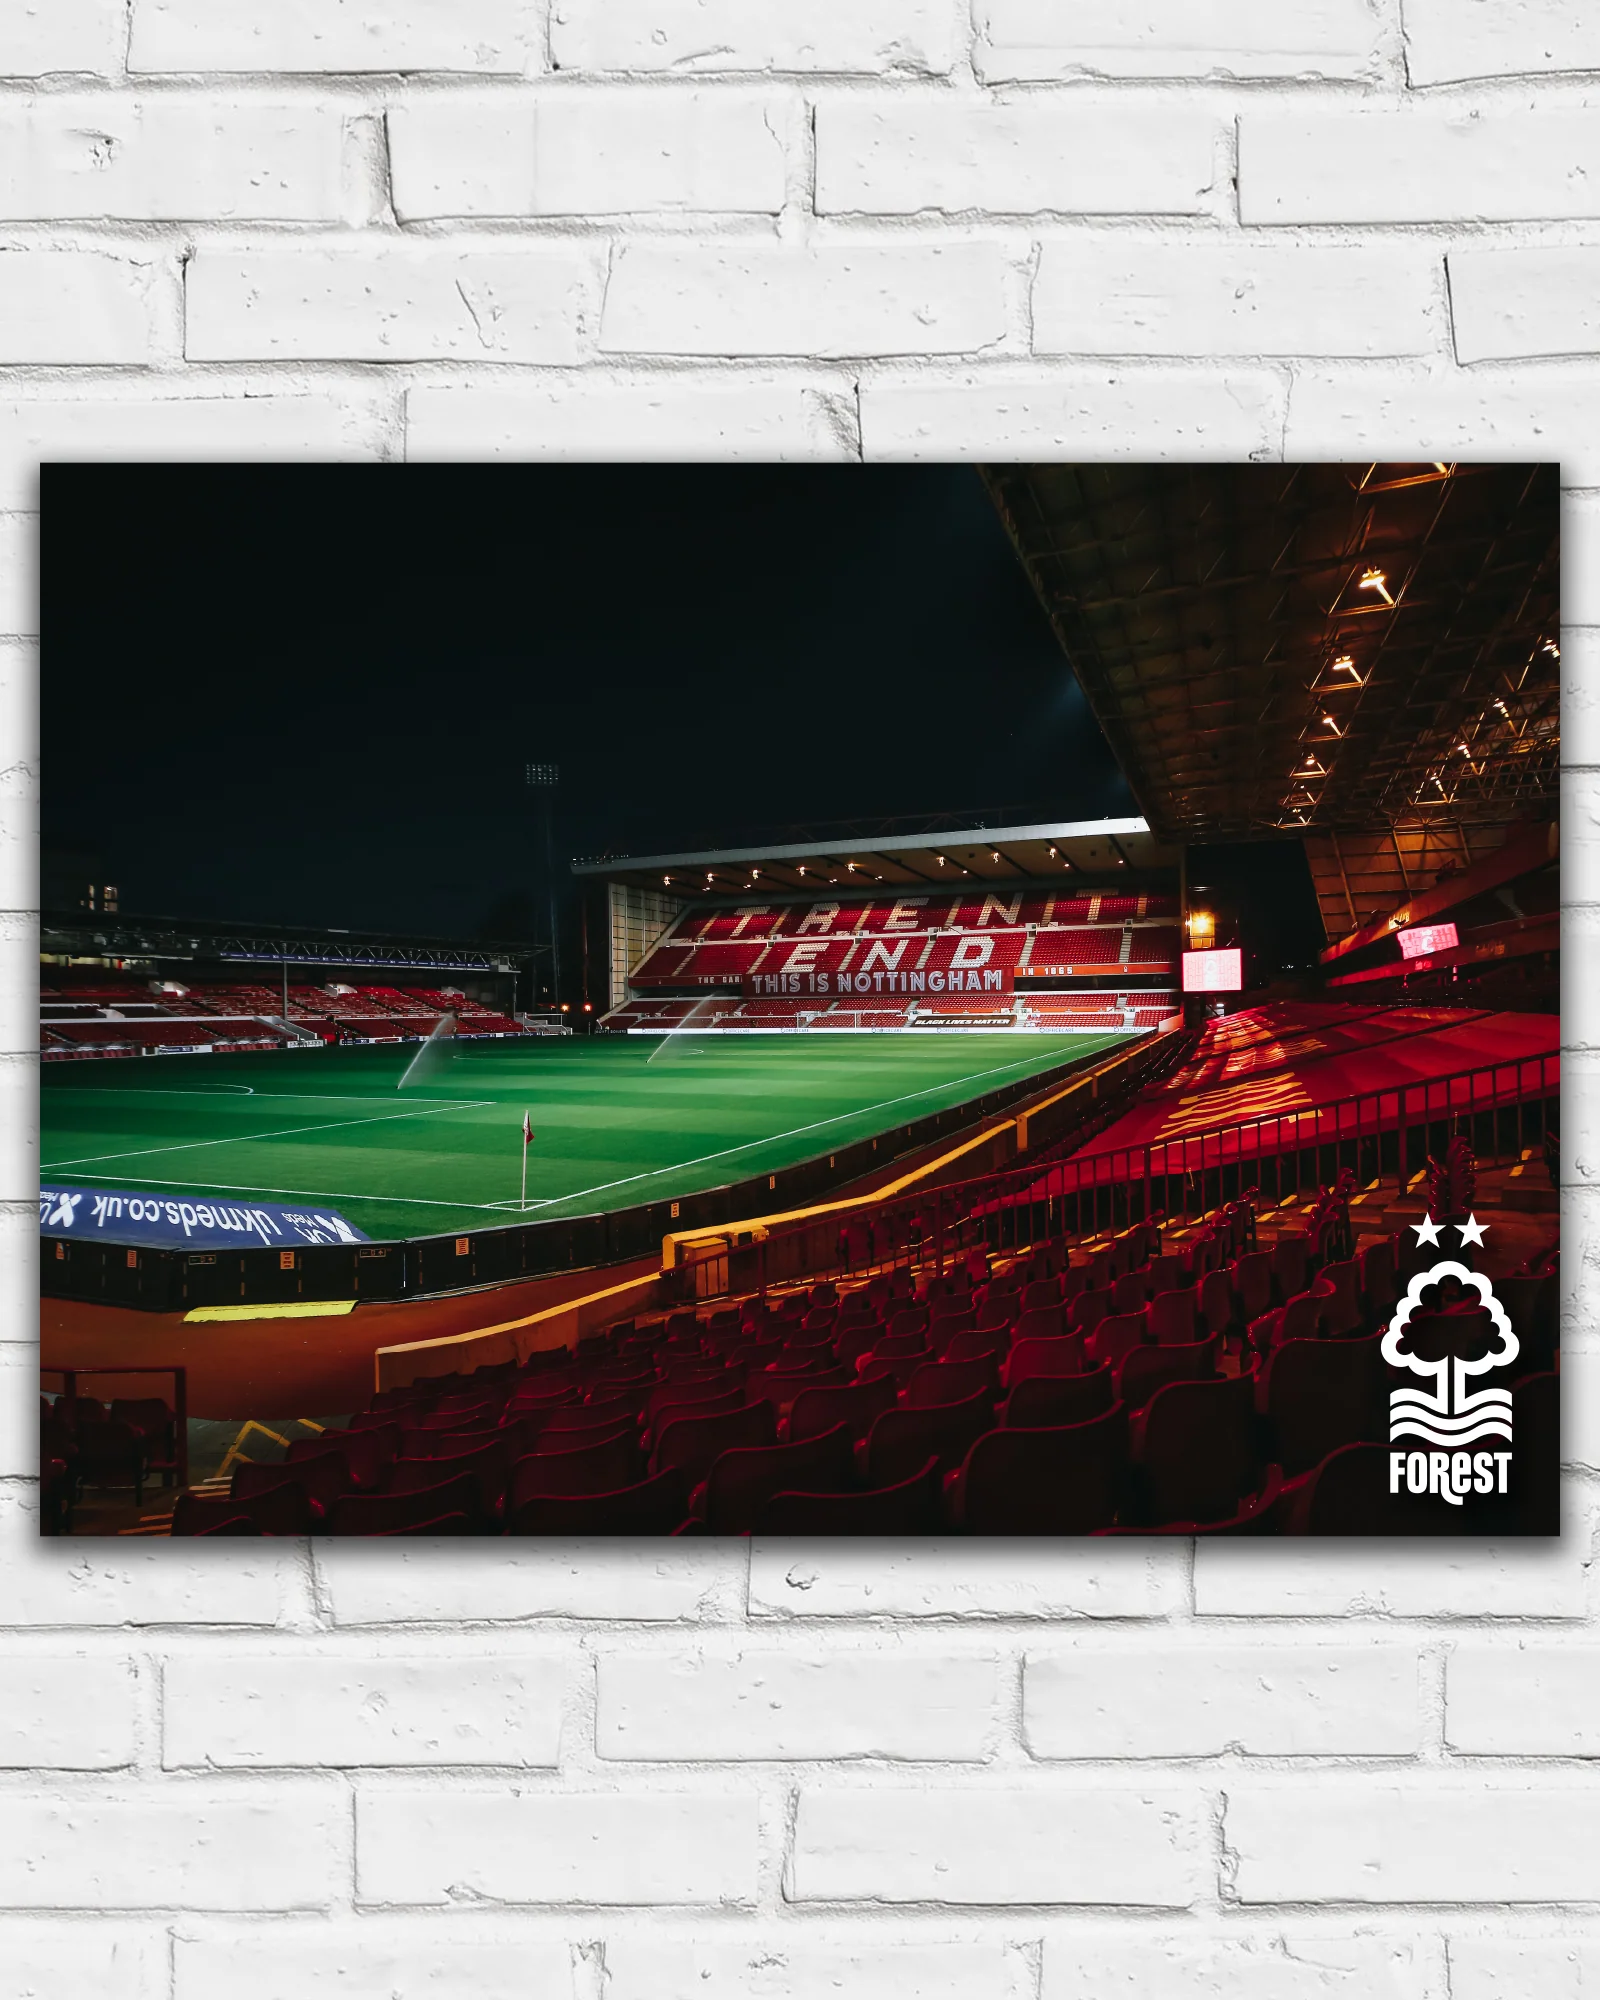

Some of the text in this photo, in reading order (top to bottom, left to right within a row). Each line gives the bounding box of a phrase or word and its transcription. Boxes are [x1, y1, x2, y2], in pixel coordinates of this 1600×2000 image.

[730, 888, 1120, 937] TRENT
[780, 935, 995, 974] END
[697, 976, 715, 984] THE
[752, 969, 1003, 994] THIS IS NOTTINGHAM
[1022, 966, 1073, 976] IN 1865
[90, 1195, 283, 1246] ukmeds.co.uk
